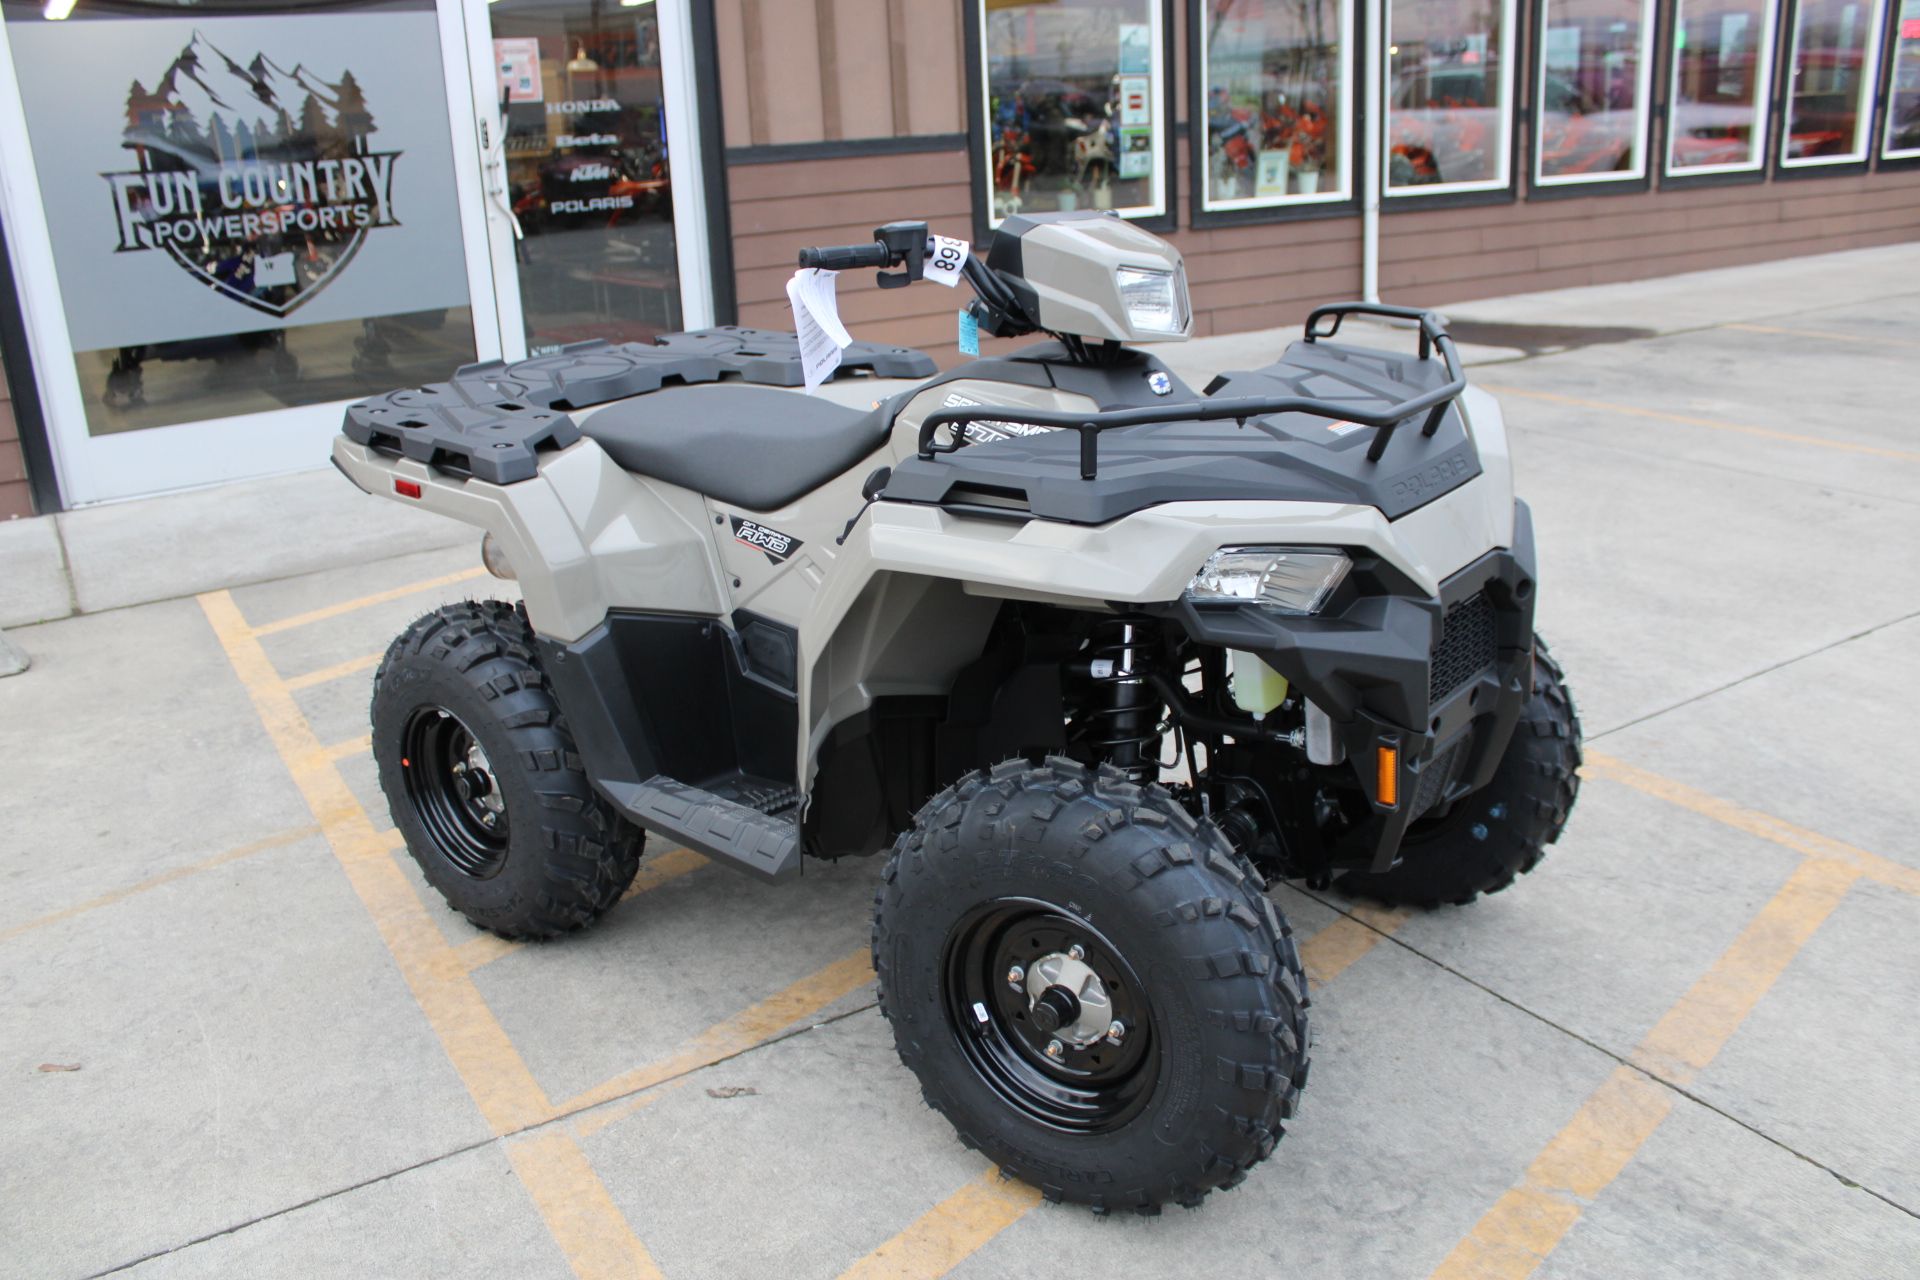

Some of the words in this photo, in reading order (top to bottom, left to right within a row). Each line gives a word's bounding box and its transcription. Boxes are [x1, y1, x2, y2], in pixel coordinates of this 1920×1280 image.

[547, 99, 621, 115] HONDA
[555, 132, 619, 148] Beta
[570, 163, 611, 182] KTM
[106, 169, 205, 250] FUN
[218, 153, 402, 227] COUNTRY
[551, 195, 634, 215] POLARIS
[154, 203, 370, 245] POWERSPORTS
[735, 525, 789, 554] AWD
